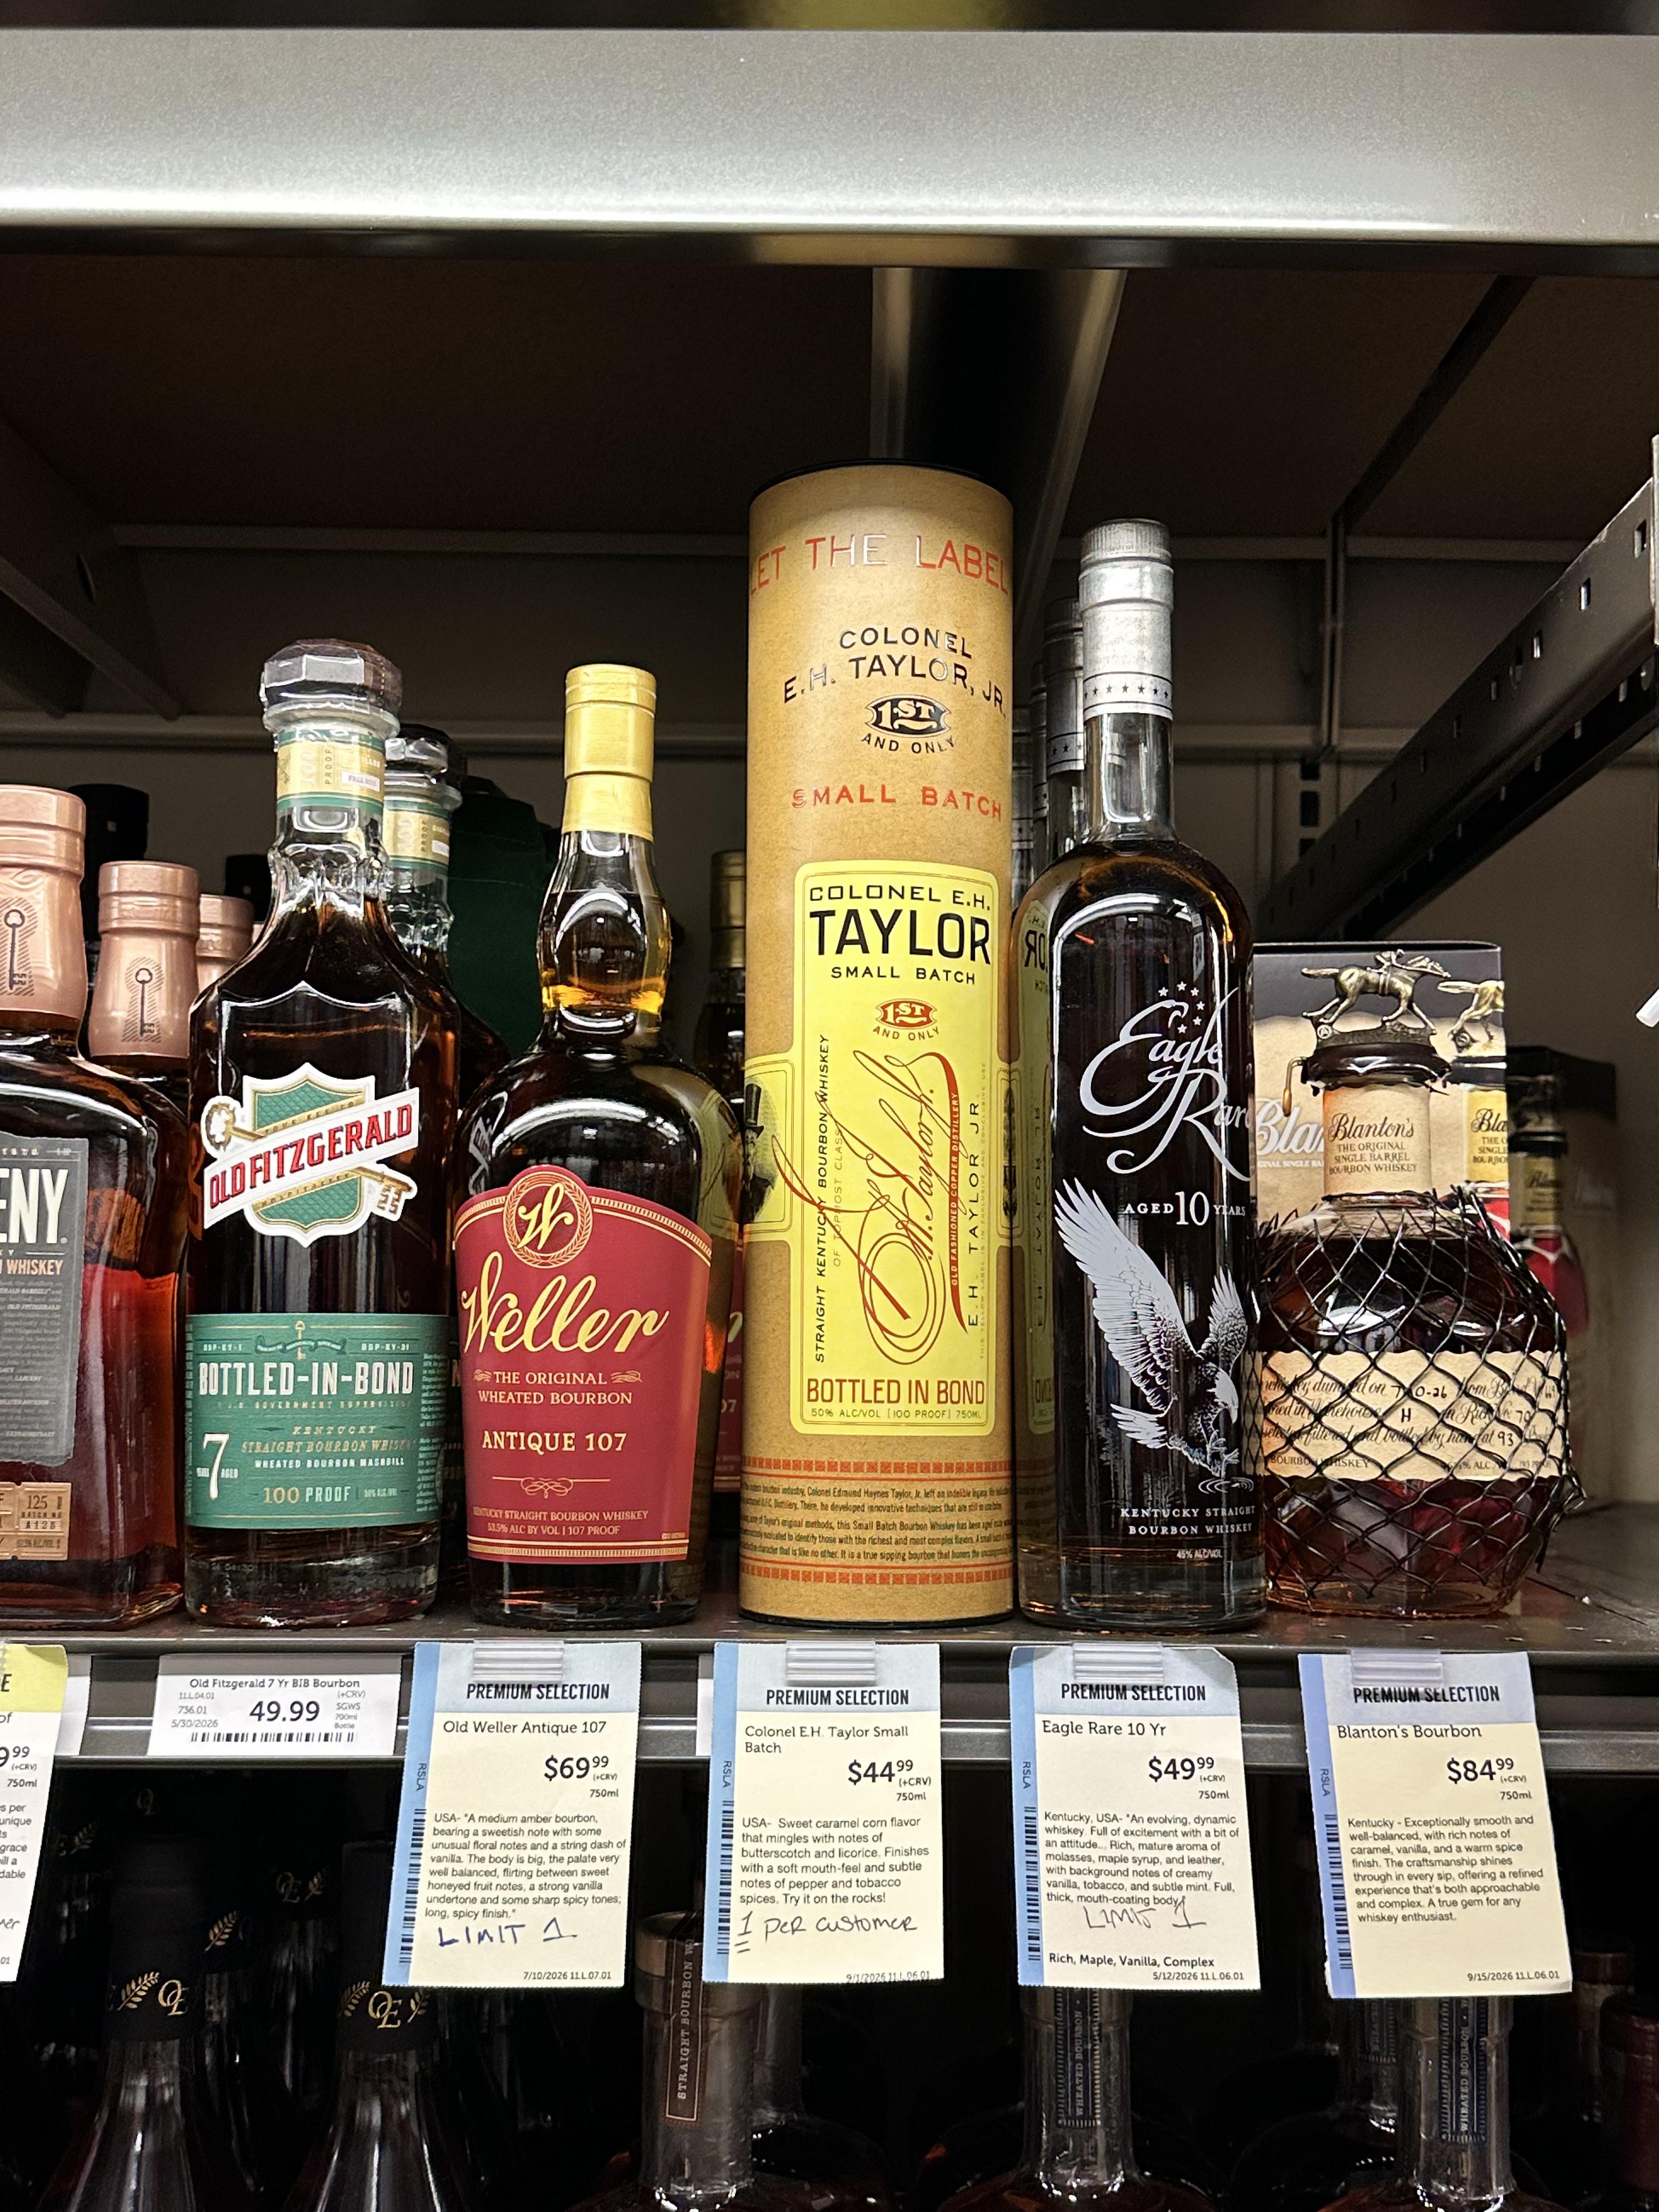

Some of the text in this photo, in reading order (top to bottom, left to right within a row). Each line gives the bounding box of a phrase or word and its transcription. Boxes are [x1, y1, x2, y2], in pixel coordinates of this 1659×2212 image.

[805, 534, 887, 569] THE
[916, 535, 1008, 596] LABEL
[839, 626, 972, 659] COLONEL
[784, 663, 836, 704] E.H.
[861, 733, 956, 753] AND ONLY
[324, 748, 334, 786] PROOF
[792, 784, 1001, 819] SMALL BATCH
[810, 885, 990, 911] COLONEL E.H.
[810, 909, 991, 965] TAYLOR
[831, 967, 975, 985] SMALL BATCH
[872, 1026, 939, 1041] AND ONLY
[950, 1092, 958, 1152] DISTILLERY
[1328, 1113, 1415, 1143] Blanton's
[209, 1103, 413, 1207] OLD FITZGERALD
[1336, 1142, 1405, 1153] THE ORIGINAL
[1333, 1152, 1410, 1165] SINGLE BARREL
[1328, 1163, 1417, 1176] BOURBON WHISKEY
[815, 1034, 828, 1363] STRAIGHT KENTUCKY BOURBON WHISKEY
[1121, 1191, 1245, 1226] AGED 10 YEARS
[7, 1259, 64, 1277] WHISKEY
[460, 1250, 670, 1354] Weller
[198, 1360, 414, 1397] BOTTLED-IN-BOND
[493, 1372, 607, 1384] THE ORIGINAL
[478, 1391, 632, 1404] WHEATED BOURBON
[808, 1378, 984, 1404] BOTTLED IN BOND
[811, 1408, 833, 1417] 50%
[839, 1409, 881, 1418] ALC/VOL
[292, 1425, 377, 1436] KENTUCKY
[241, 1440, 369, 1454] STRAIGHT BOURBON
[482, 1431, 627, 1455] ANTIQUE 107
[202, 1433, 232, 1500] 7
[255, 1457, 404, 1469] WHEATED BOURBON MASHBILL
[262, 1485, 352, 1505] 100 PROOF
[808, 1486, 831, 1497] Colonel
[833, 1487, 861, 1497] Edmund
[864, 1488, 889, 1500] Haynes
[26, 1494, 48, 1510] 125
[505, 1510, 648, 1521] STRAIGHT BOURBON WHISKEY
[1120, 1505, 1255, 1517] KENTUCKY STRAIGHT
[1129, 1523, 1252, 1534] BOURBON WHISKEY
[190, 1679, 359, 1690] Old Fitzgerald 7 Yr BIB Bourbon
[466, 1684, 610, 1700] PREMIUM SELECTION
[1062, 1684, 1206, 1701] PREMIUM SELECTION
[766, 1689, 909, 1706] PREMIUM SELECTION
[1353, 1685, 1500, 1703] PREMIUM SELECTION
[178, 1706, 207, 1714] 736.01
[250, 1701, 319, 1722] 49.99
[171, 1719, 218, 1728] 5/30/2026
[443, 1720, 606, 1736] Old Weller Antique 107
[1042, 1720, 1166, 1736] Eagle Rare 10 Yr
[1337, 1724, 1482, 1739] Blanton's Bourbon
[745, 1726, 795, 1737] Colonel
[828, 1726, 870, 1740] Taylor
[874, 1726, 908, 1737] Small
[13, 1746, 30, 1758] 99
[745, 1742, 781, 1753] Batch
[416, 1763, 427, 1791] RSLA
[723, 1761, 732, 1788] RSLA
[899, 1776, 931, 1787] (+CRV)
[590, 1788, 618, 1797] 750ml
[896, 1792, 926, 1801] 750ml
[1199, 1791, 1229, 1799] 750ml
[1500, 1791, 1532, 1800] 750ml
[435, 1813, 460, 1822] USA-
[478, 1814, 517, 1823] medium
[521, 1814, 552, 1823] amber
[555, 1814, 597, 1823] bourbon,
[743, 1817, 921, 1828] USA- Sweet caramel corn flavor
[1045, 1812, 1093, 1824] Kentucky,
[1097, 1813, 1122, 1822] USA-
[1147, 1815, 1190, 1826] evolving,
[1194, 1815, 1236, 1826] dynamic
[1172, 1896, 1207, 1928] 1
[1358, 1912, 1456, 1924] whiskey enthusiast.
[438, 1917, 578, 1947] LIMIT 1
[1049, 1953, 1214, 1969] Rich, Maple, Vanilla, Complex
[1467, 1972, 1513, 1981] 9/15/2026
[678, 1960, 693, 2100] STRAIGHT BOURBON
[1074, 2008, 1086, 2118] WHEATED BOURBON
